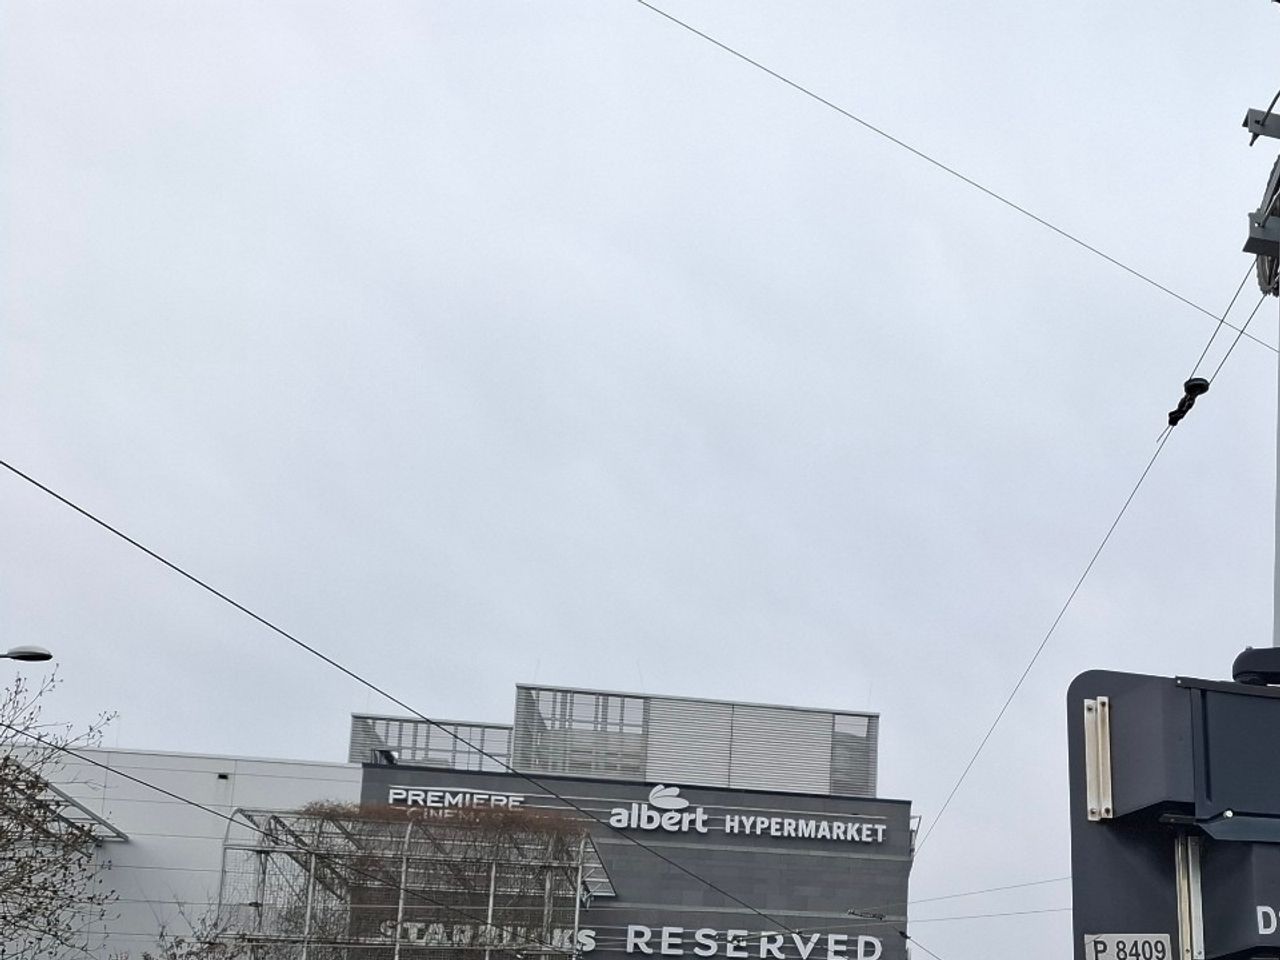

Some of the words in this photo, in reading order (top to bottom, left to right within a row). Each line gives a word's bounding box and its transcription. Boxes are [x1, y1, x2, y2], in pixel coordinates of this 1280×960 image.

[609, 802, 708, 834] albert
[725, 814, 886, 843] HYPERMARKET
[1094, 940, 1107, 960] P
[1116, 940, 1167, 960] 8409
